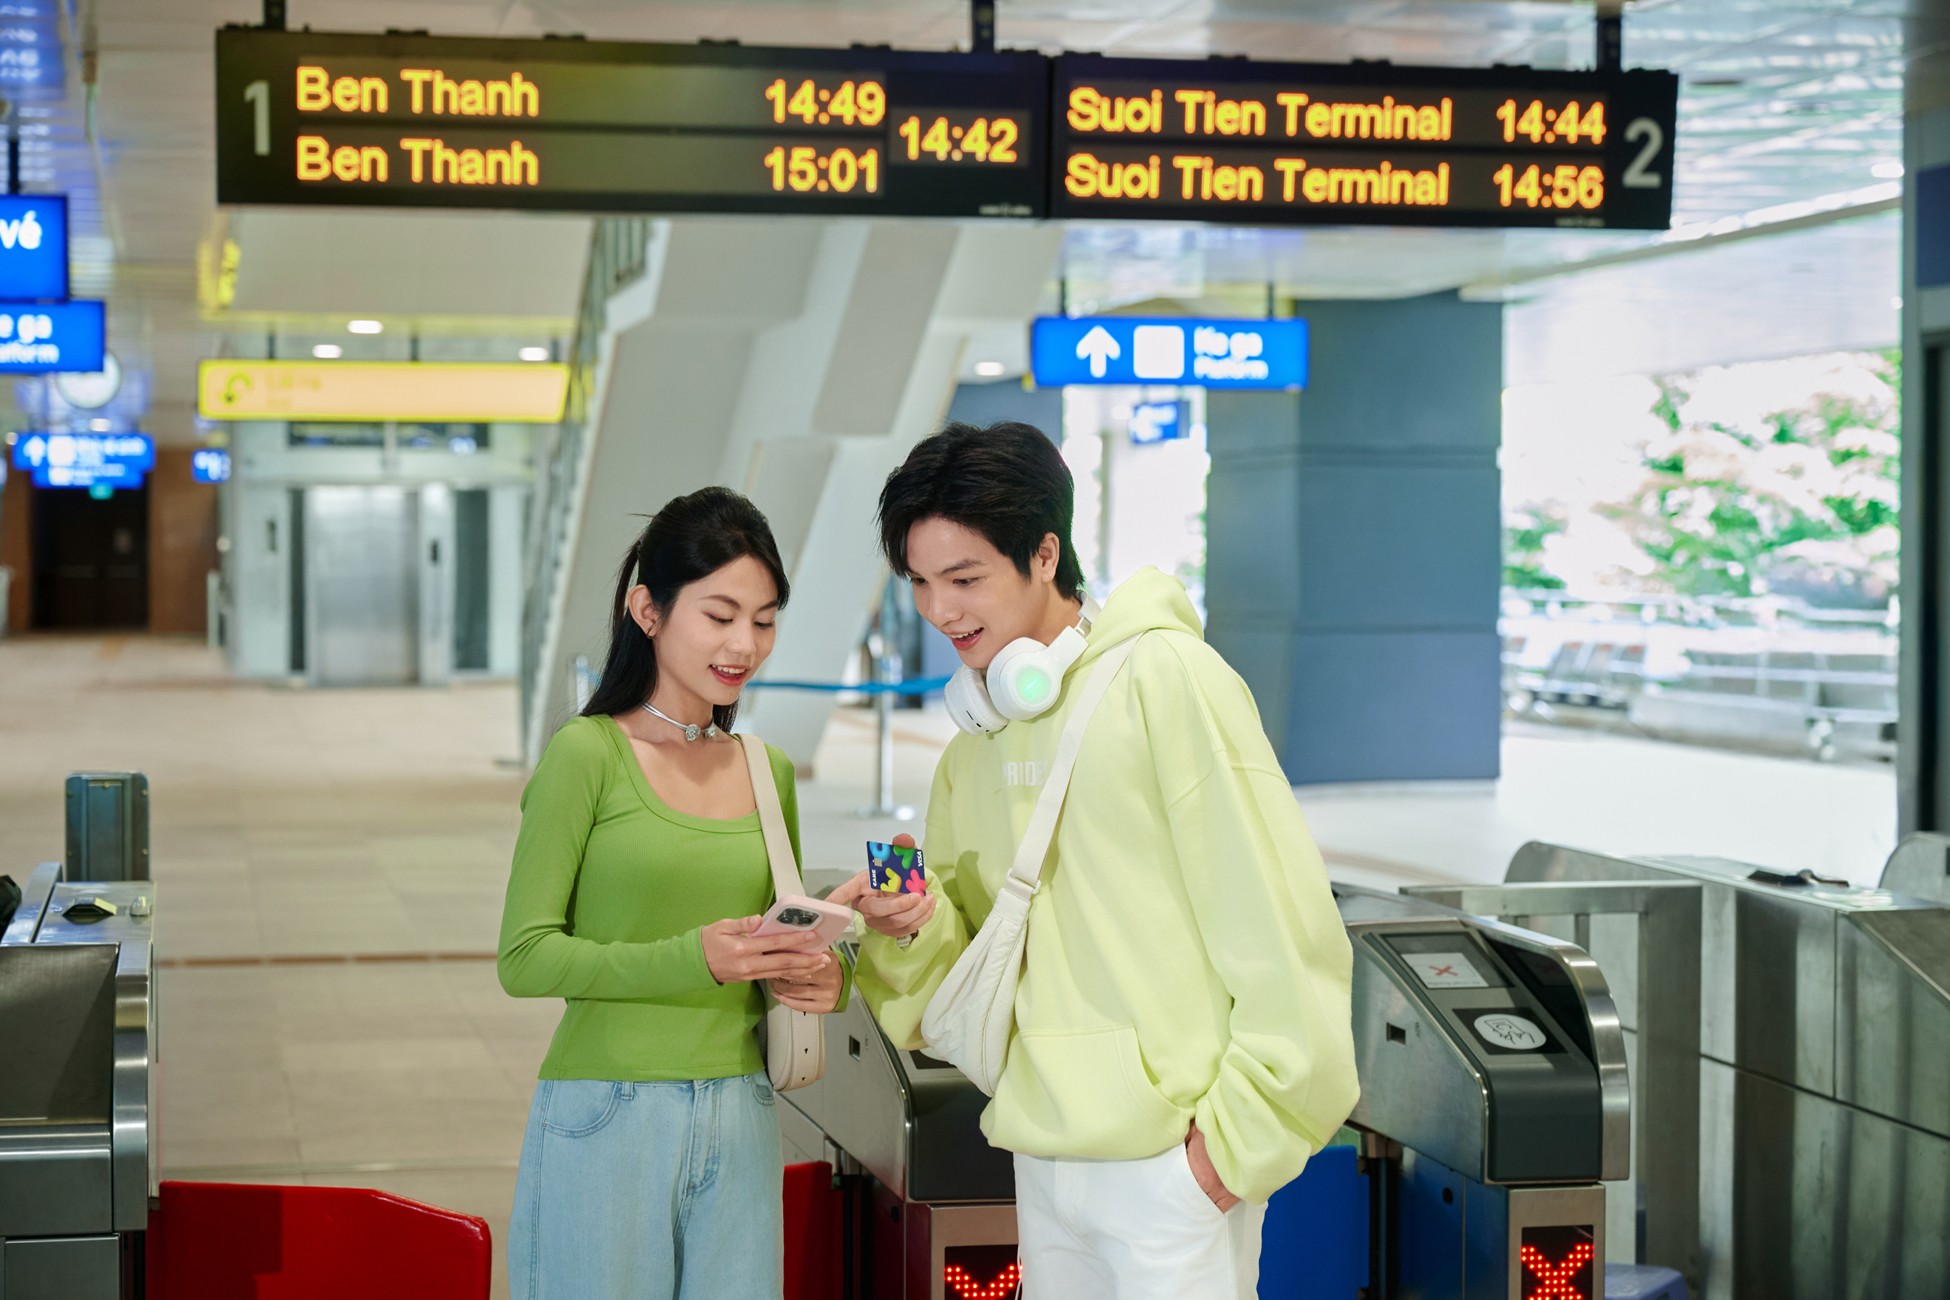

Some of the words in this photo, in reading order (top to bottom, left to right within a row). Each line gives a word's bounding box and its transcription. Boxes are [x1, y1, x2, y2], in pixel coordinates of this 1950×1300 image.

[296, 65, 389, 114] Ben
[399, 68, 540, 118] Thanh
[764, 78, 886, 127] 14:49
[1066, 86, 1163, 134] Suoi
[1174, 89, 1267, 136] Tien
[1276, 92, 1453, 141] Terminal
[244, 80, 271, 155] 1
[898, 115, 1019, 163] 14:42
[1496, 98, 1607, 145] 14:44
[296, 135, 389, 183] Ben
[399, 137, 540, 186] Thanh
[763, 145, 879, 193] 15:01
[1621, 117, 1664, 189] 2
[1064, 152, 1161, 199] Suoi
[1172, 155, 1265, 202] Tien
[1273, 157, 1450, 206] Terminal
[1492, 163, 1605, 209] 14:56
[0, 314, 14, 338] e
